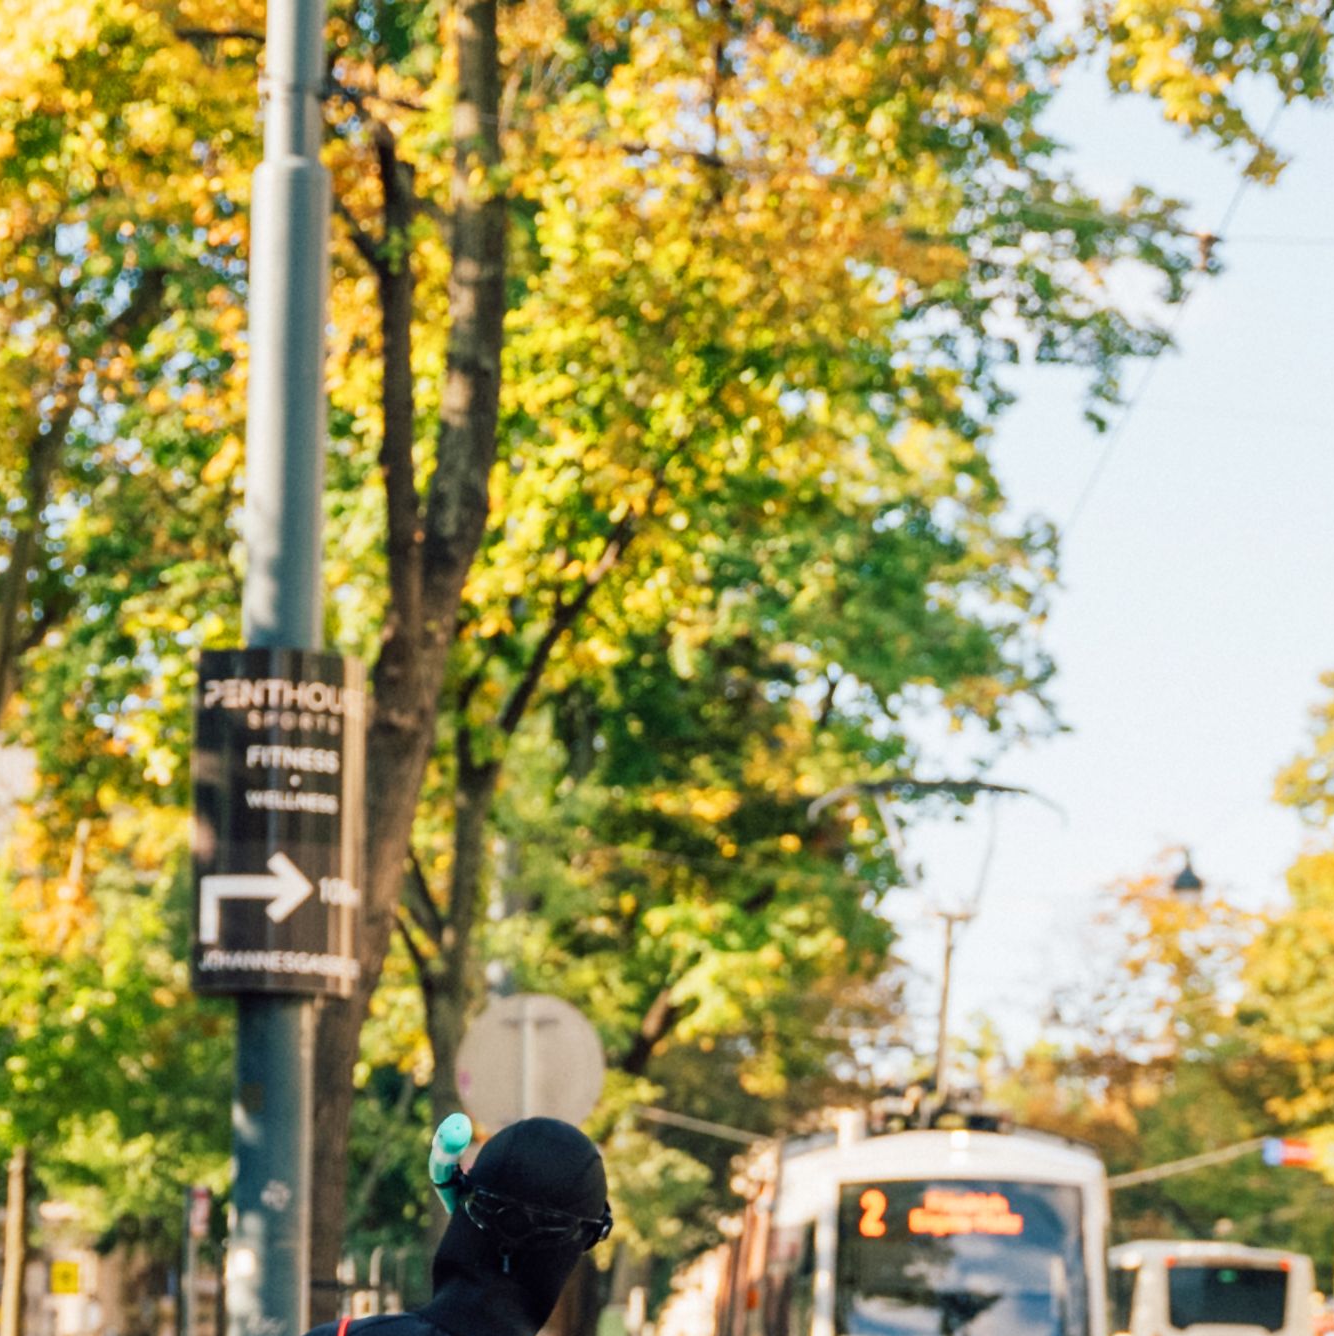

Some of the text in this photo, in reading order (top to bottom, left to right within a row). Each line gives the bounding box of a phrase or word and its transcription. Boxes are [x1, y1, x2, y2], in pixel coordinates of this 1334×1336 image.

[246, 744, 340, 775] FITNESS
[244, 789, 339, 815] WELLNESS
[859, 1188, 887, 1238] 2
